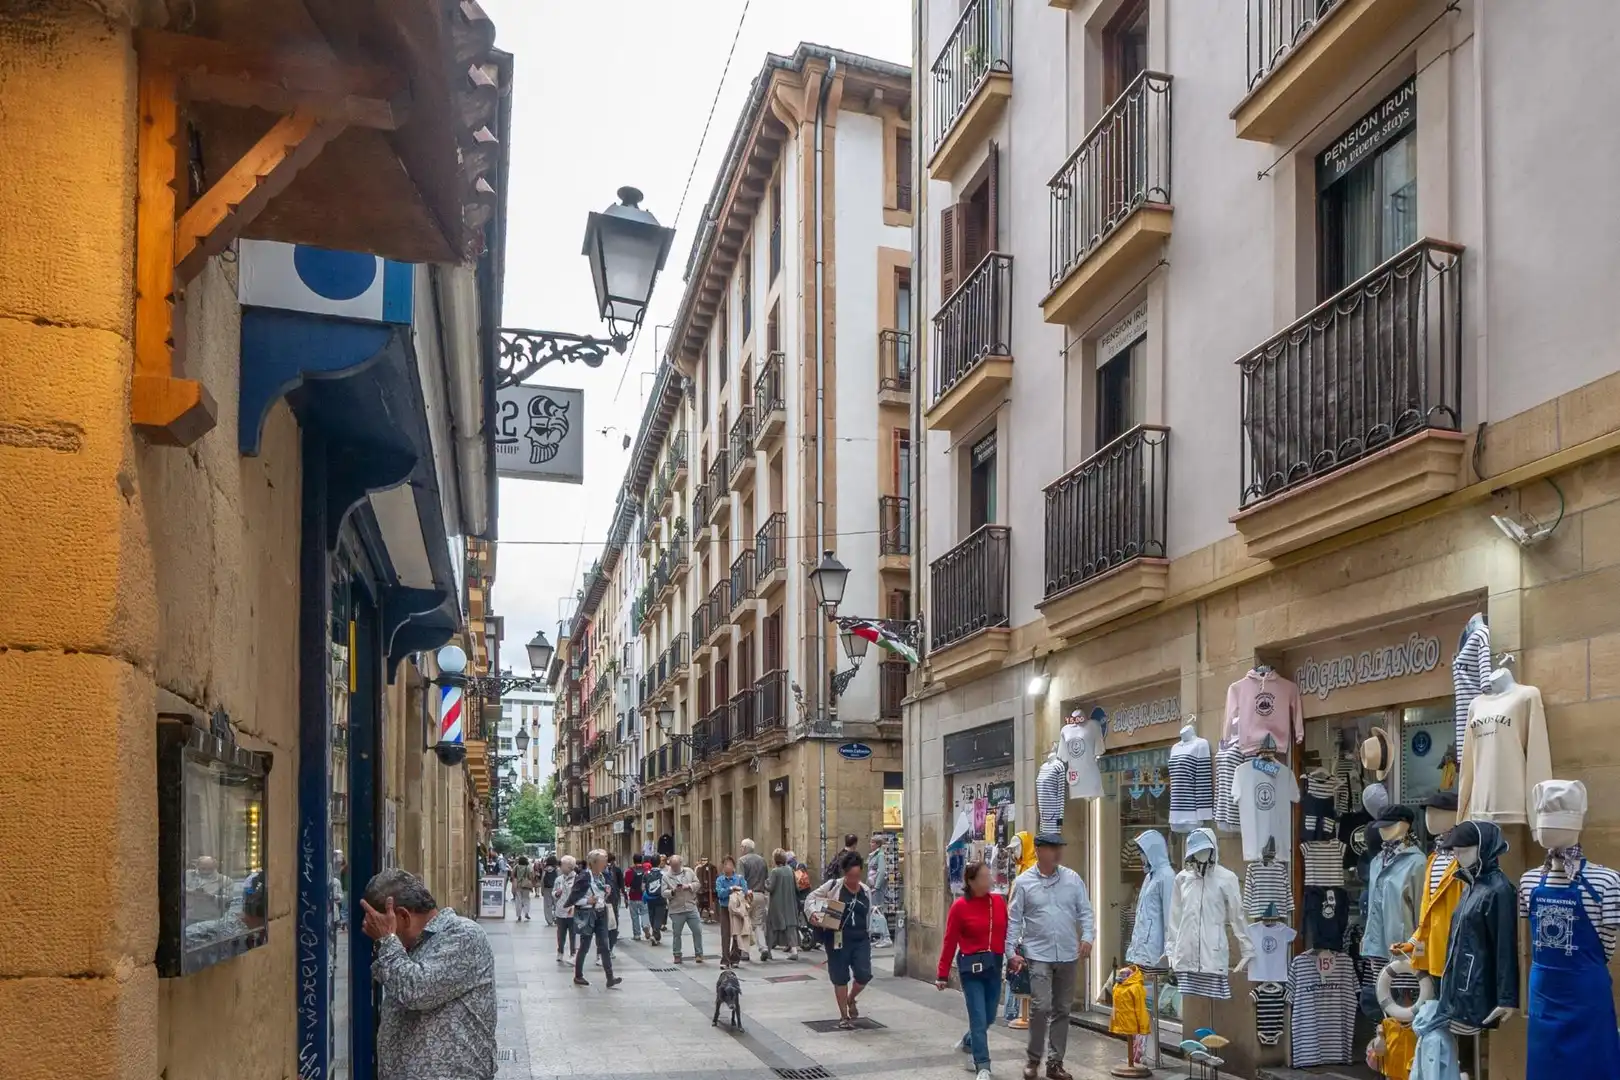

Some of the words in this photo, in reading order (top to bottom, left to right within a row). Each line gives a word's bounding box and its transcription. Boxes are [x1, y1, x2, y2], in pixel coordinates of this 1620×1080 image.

[1324, 111, 1378, 166] PENSIÓN
[1335, 157, 1347, 173] by
[1349, 131, 1380, 162] vivere
[1382, 107, 1410, 136] stays
[1101, 318, 1132, 348] PENSIÓN
[495, 400, 519, 436] 2
[1296, 655, 1355, 700] HOGAR
[1356, 631, 1440, 684] BLANCO
